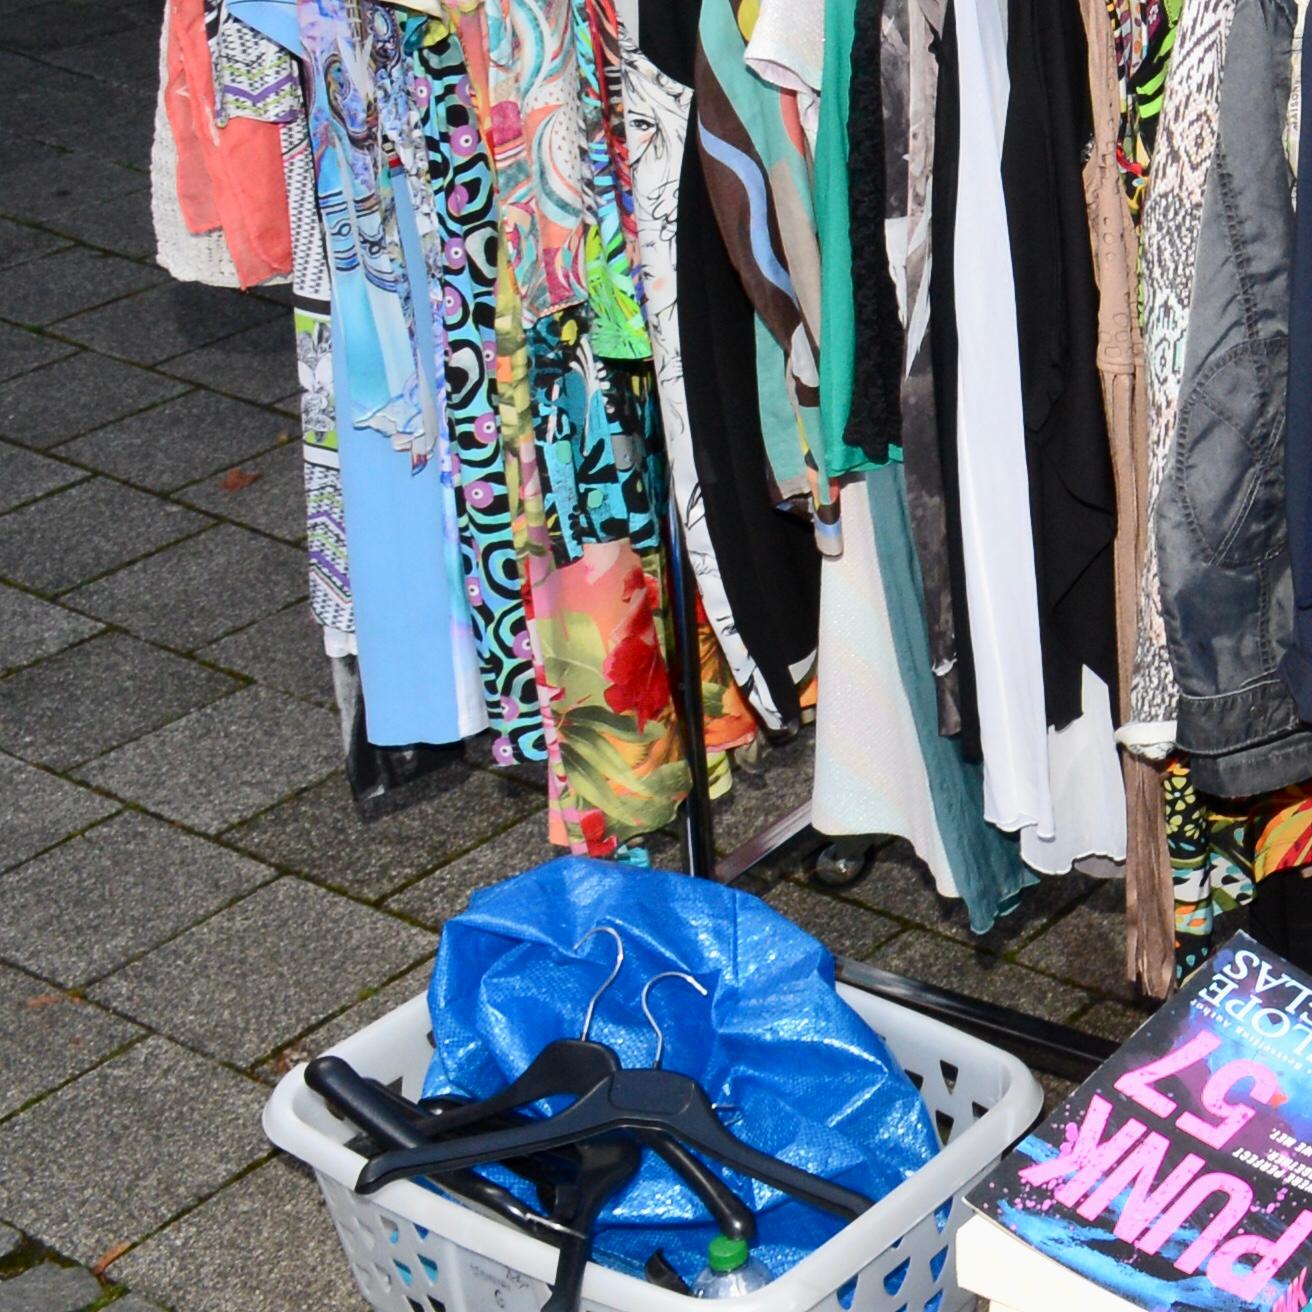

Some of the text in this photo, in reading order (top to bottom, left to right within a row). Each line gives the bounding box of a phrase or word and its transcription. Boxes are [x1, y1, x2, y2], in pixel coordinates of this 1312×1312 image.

[1190, 998, 1232, 1028] Author
[1114, 1029, 1277, 1150] 57
[1269, 1128, 1297, 1148] MET.
[1232, 1147, 1286, 1178] PERFECT
